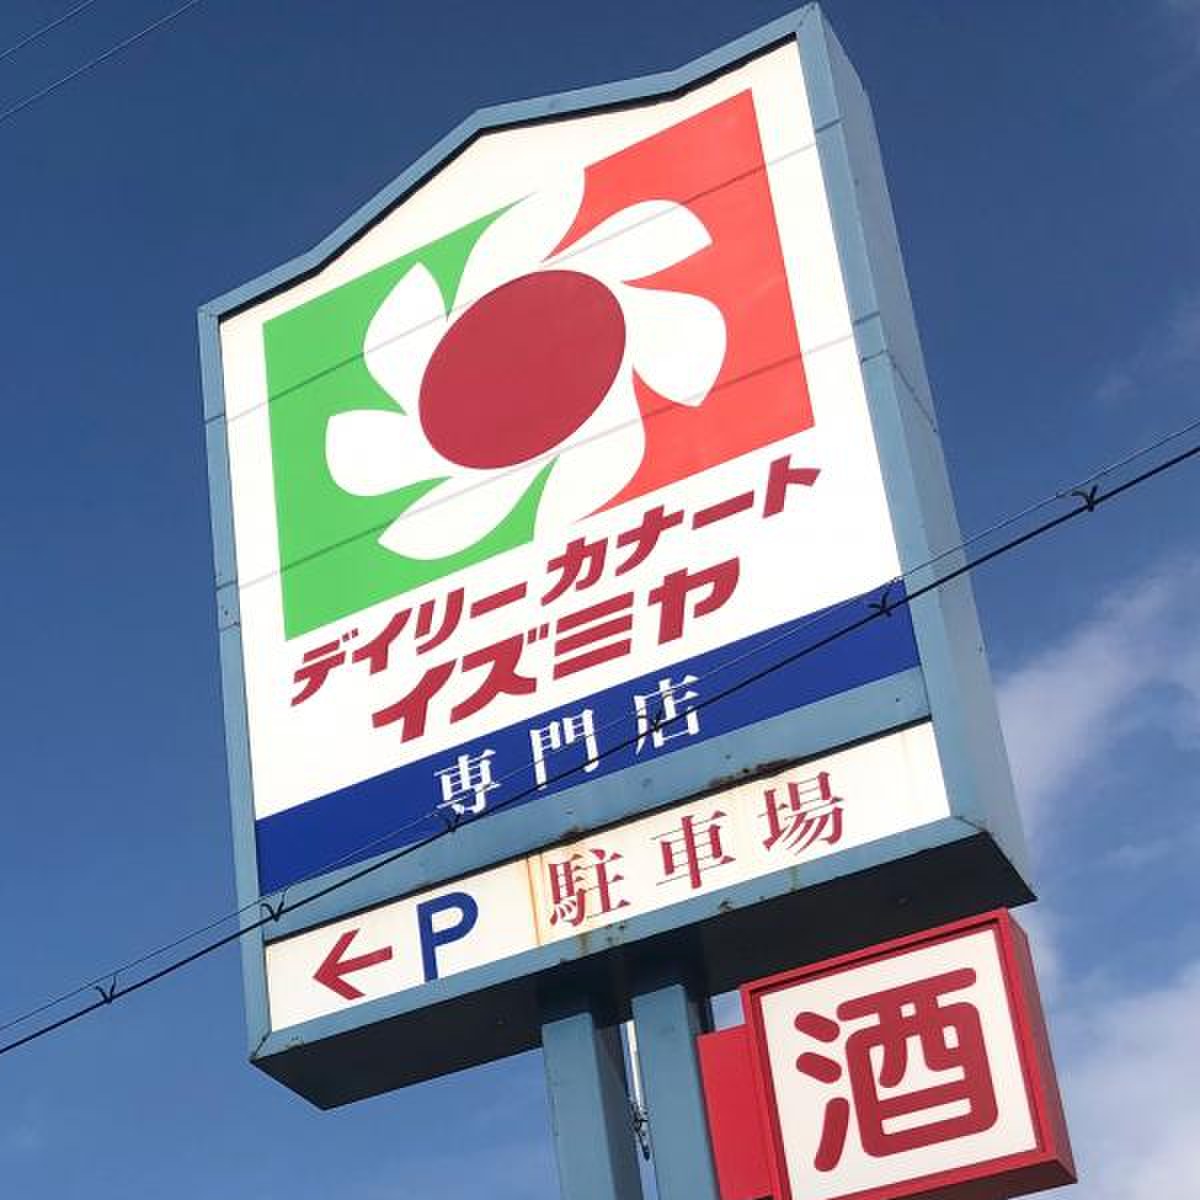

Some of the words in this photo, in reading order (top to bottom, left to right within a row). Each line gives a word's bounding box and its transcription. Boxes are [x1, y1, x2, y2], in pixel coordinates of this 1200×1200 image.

[290, 455, 820, 707] デイリーカナート
[371, 556, 741, 743] イズミヤ
[436, 674, 700, 818] 専門店
[417, 890, 478, 980] P
[548, 770, 844, 928] 駐車場
[794, 967, 999, 1172] 酒
